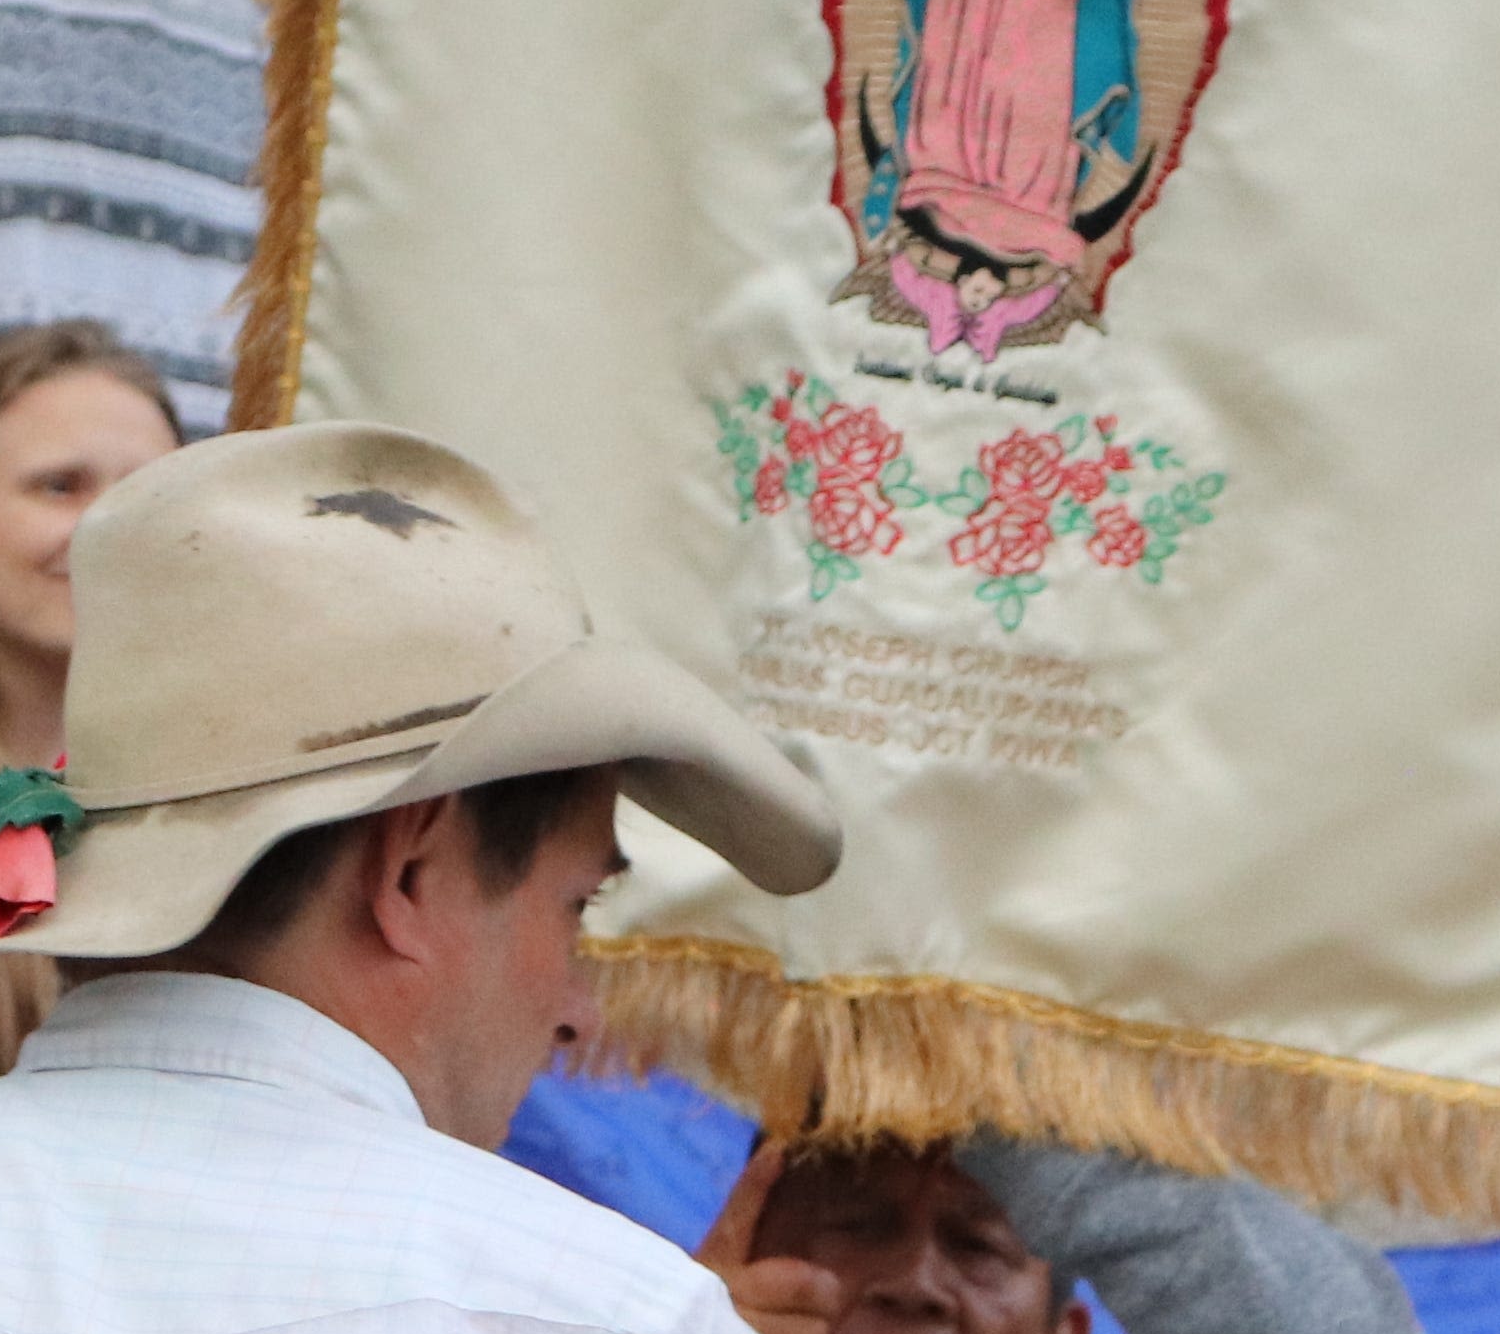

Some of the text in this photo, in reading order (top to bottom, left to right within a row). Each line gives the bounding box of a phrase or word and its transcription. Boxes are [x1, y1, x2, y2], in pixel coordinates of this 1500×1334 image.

[812, 623, 935, 669] JOSEPH
[950, 644, 1091, 689] CHURCH
[990, 729, 1079, 767] IOWA
